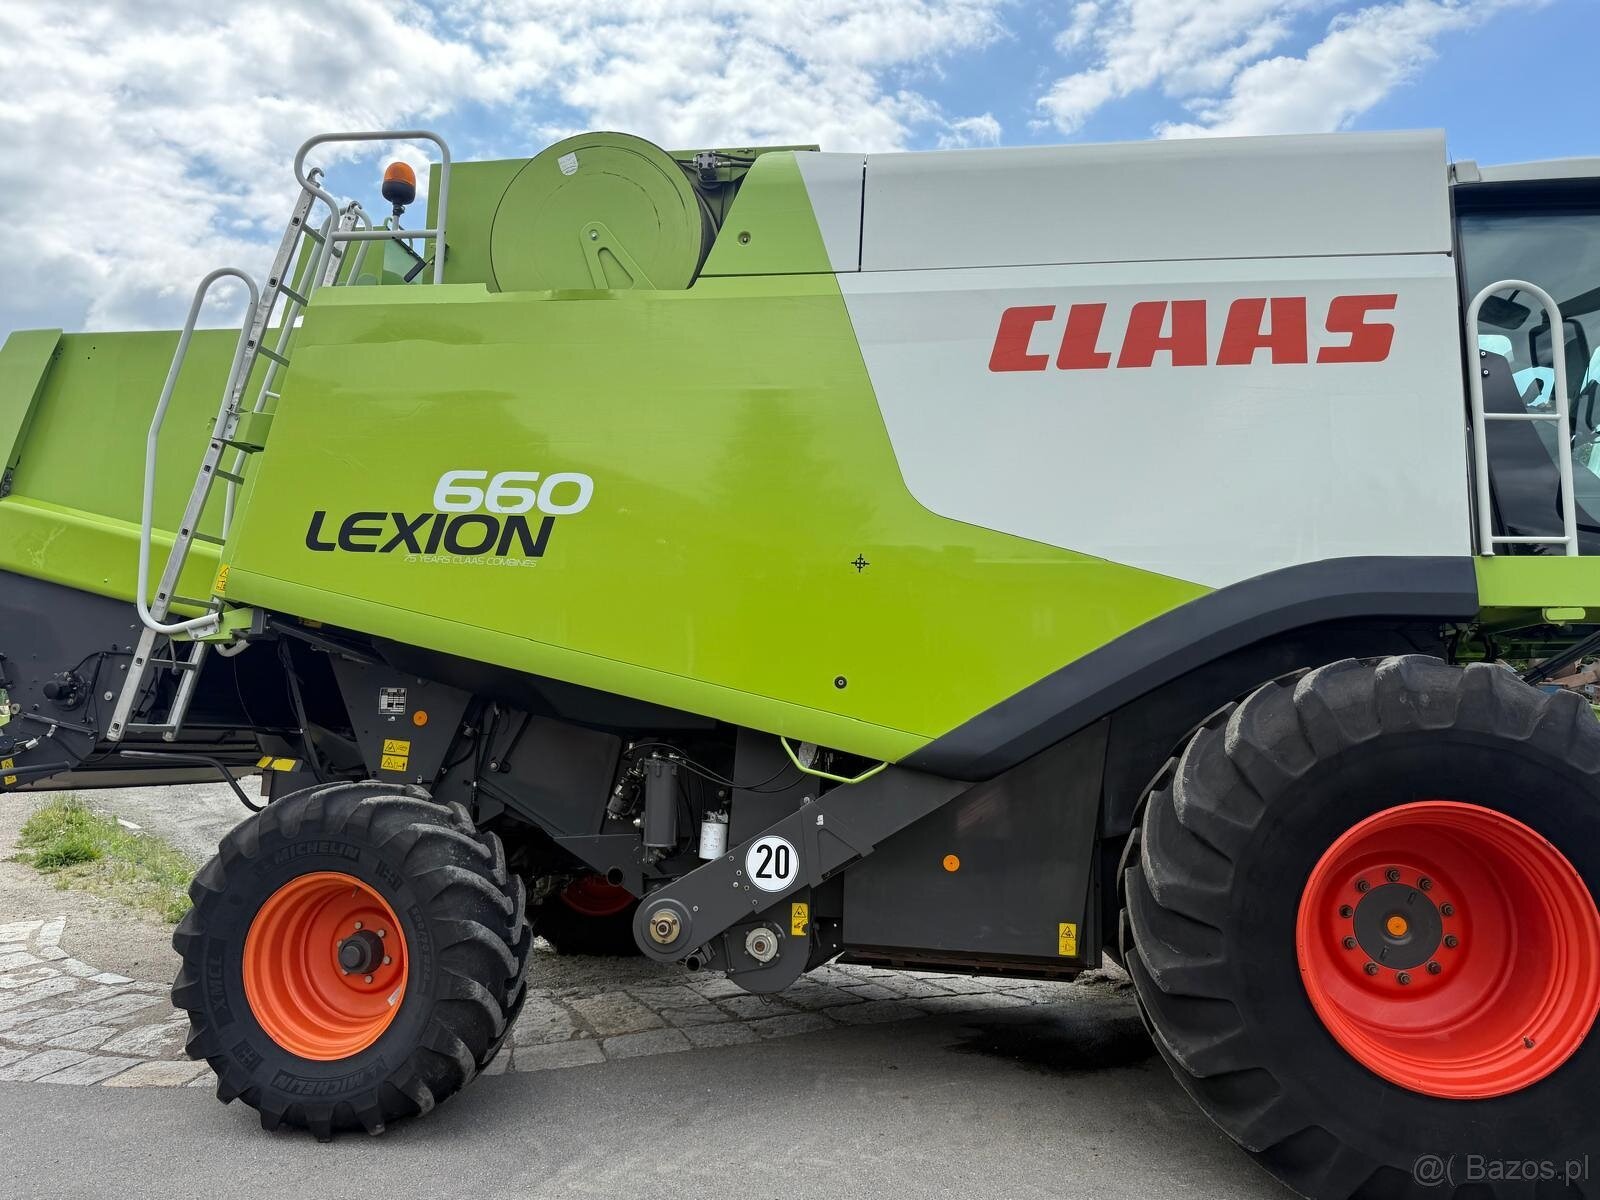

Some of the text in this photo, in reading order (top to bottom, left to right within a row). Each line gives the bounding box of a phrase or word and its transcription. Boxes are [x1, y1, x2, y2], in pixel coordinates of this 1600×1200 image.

[988, 294, 1398, 372] CLAAS
[433, 470, 594, 514] 660
[306, 511, 555, 557] LEXION
[419, 555, 450, 564] YEARS
[453, 556, 484, 565] CLAAS
[487, 557, 537, 568] COMBINES
[275, 840, 360, 865] MICHELIN
[756, 845, 789, 879] 20
[272, 1072, 364, 1096] MICHELIN
